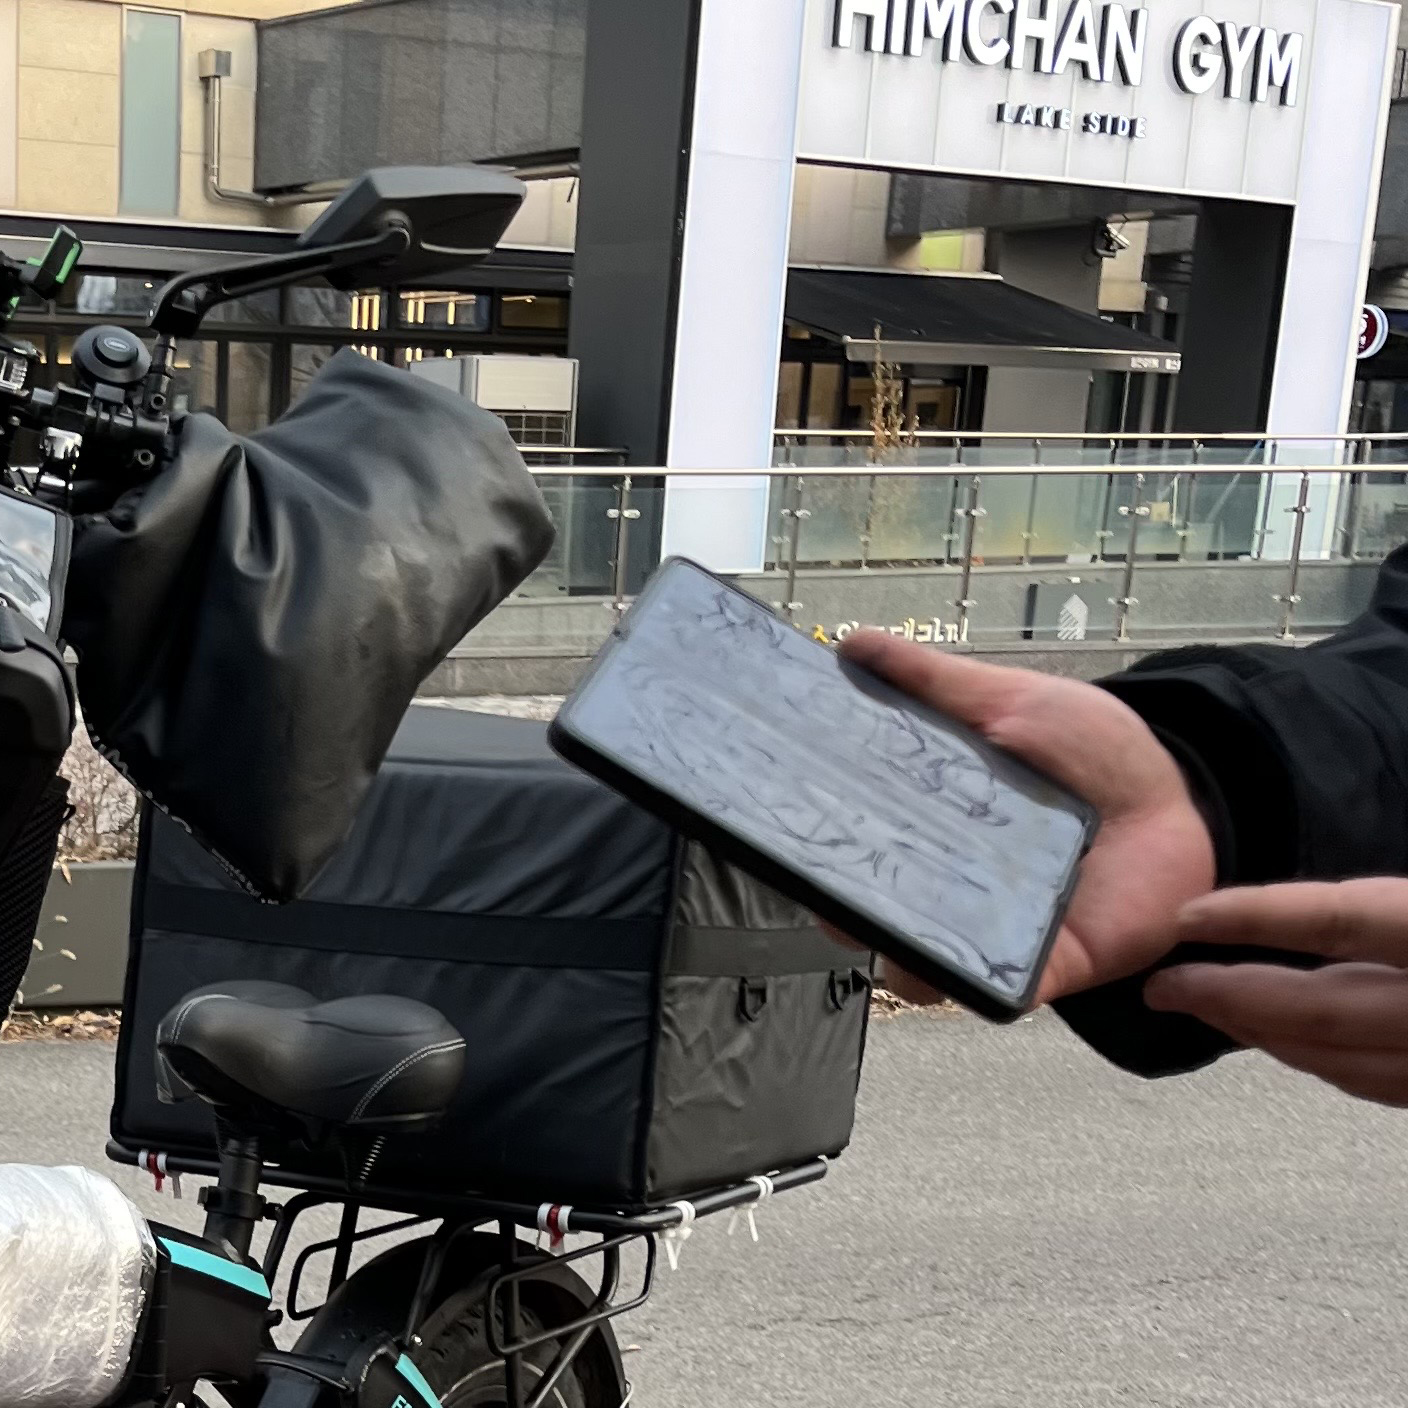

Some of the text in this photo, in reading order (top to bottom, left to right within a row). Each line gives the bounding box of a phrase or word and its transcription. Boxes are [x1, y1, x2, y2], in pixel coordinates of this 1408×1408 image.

[833, 0, 1303, 107] HIMCHAN GYM
[999, 101, 1147, 138] LAKE SIDE
